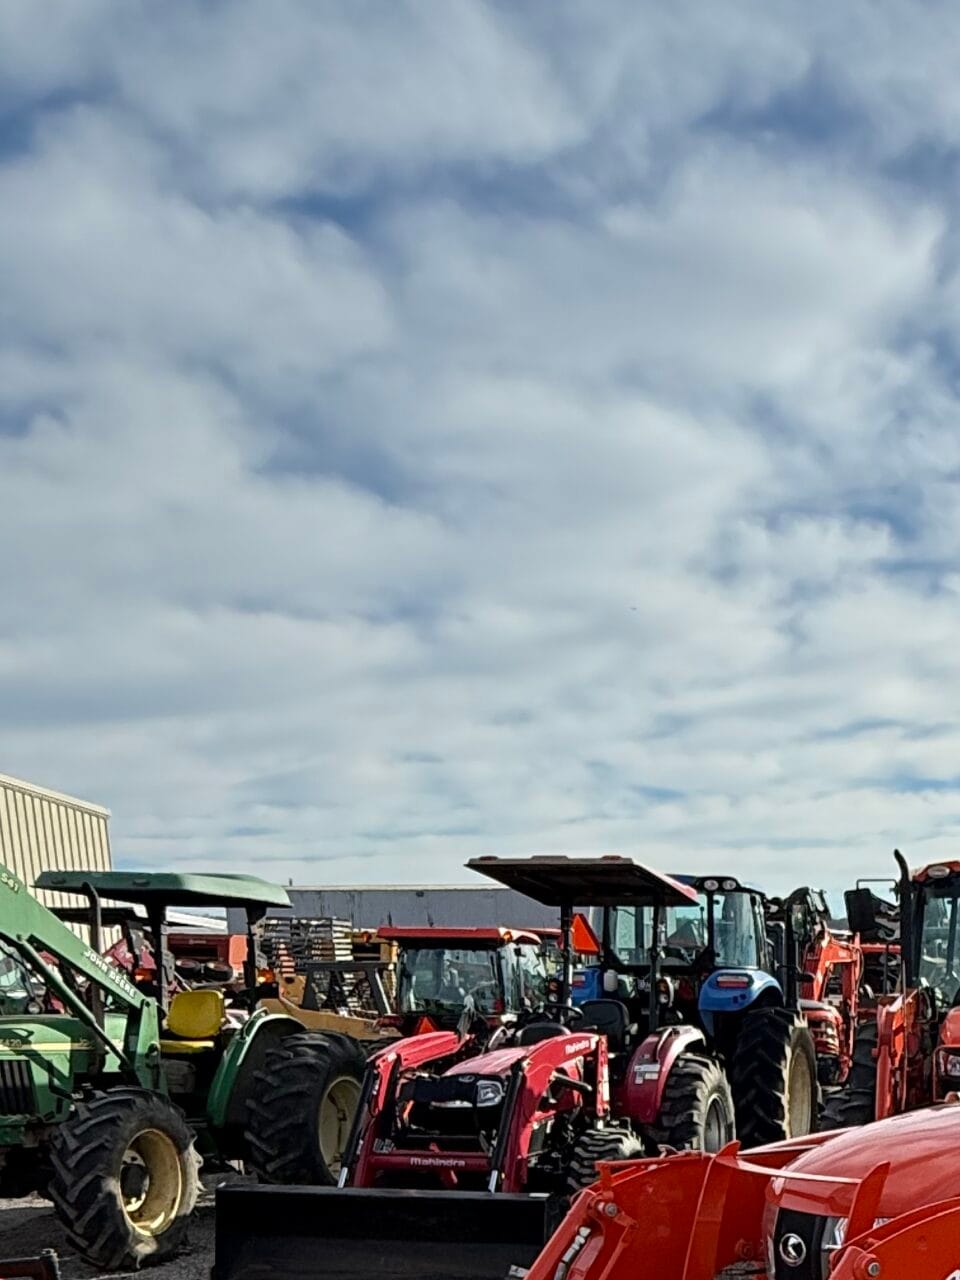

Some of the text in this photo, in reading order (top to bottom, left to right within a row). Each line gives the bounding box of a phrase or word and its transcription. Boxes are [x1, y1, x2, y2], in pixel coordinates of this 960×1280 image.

[83, 950, 135, 998] JOHN DEERE
[410, 1156, 465, 1168] Mahindra
